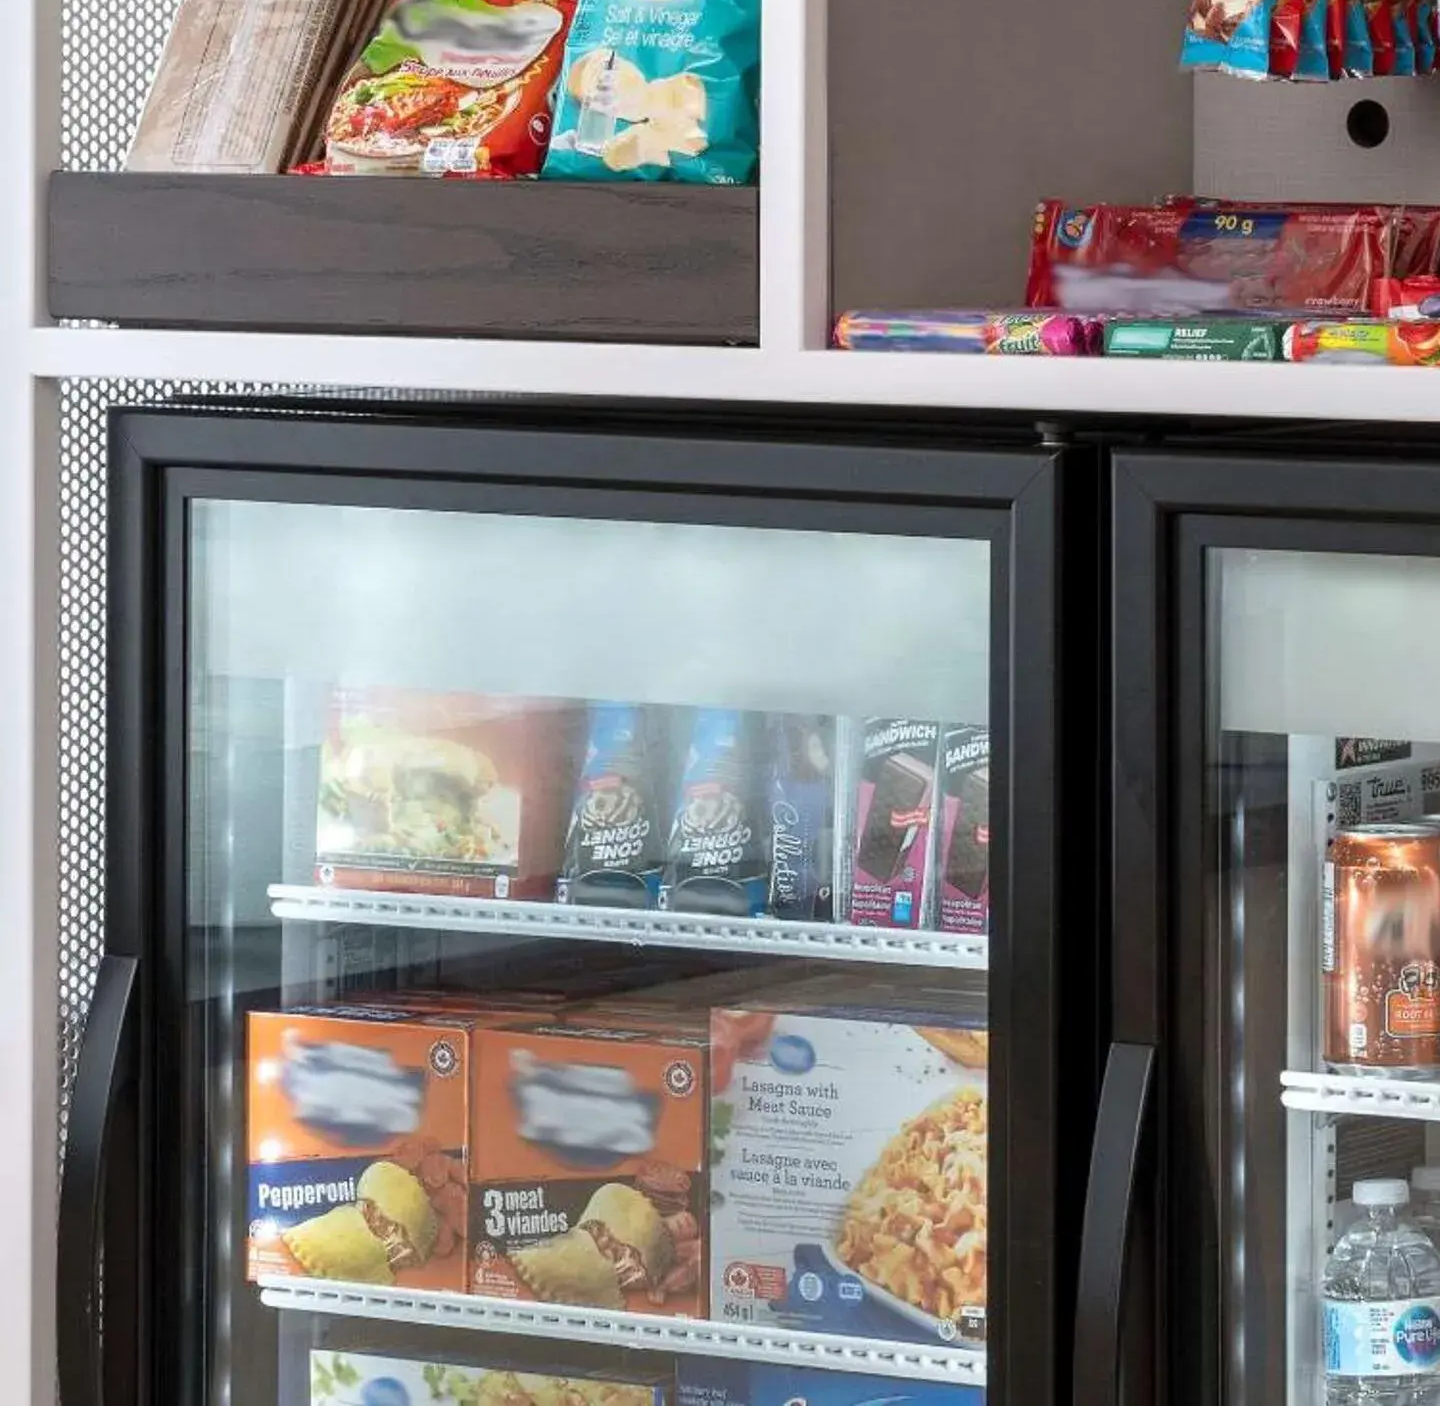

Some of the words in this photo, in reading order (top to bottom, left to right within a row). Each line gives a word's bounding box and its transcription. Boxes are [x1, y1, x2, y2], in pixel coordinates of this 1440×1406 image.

[604, 4, 632, 24] Salt
[1214, 214, 1238, 231] 90
[1241, 218, 1254, 236] g
[1173, 328, 1208, 338] RELIEF
[864, 725, 937, 755] SANDWICH
[945, 741, 988, 769] SANDW
[581, 819, 650, 846] CORNET
[681, 826, 752, 852] CORNET
[591, 839, 643, 860] CONE
[691, 845, 744, 867] CONE
[806, 1081, 839, 1100] with
[748, 1095, 785, 1114] Meat
[788, 1099, 832, 1119] Sauce
[741, 1147, 802, 1170] Lasagne
[803, 1157, 838, 1172] avec
[730, 1169, 770, 1183] sauce
[784, 1169, 798, 1186] la
[801, 1173, 851, 1192] viande
[258, 1177, 357, 1210] Pepperoni
[483, 1189, 506, 1237] 3
[506, 1185, 544, 1211] meat
[506, 1209, 569, 1236] viandes
